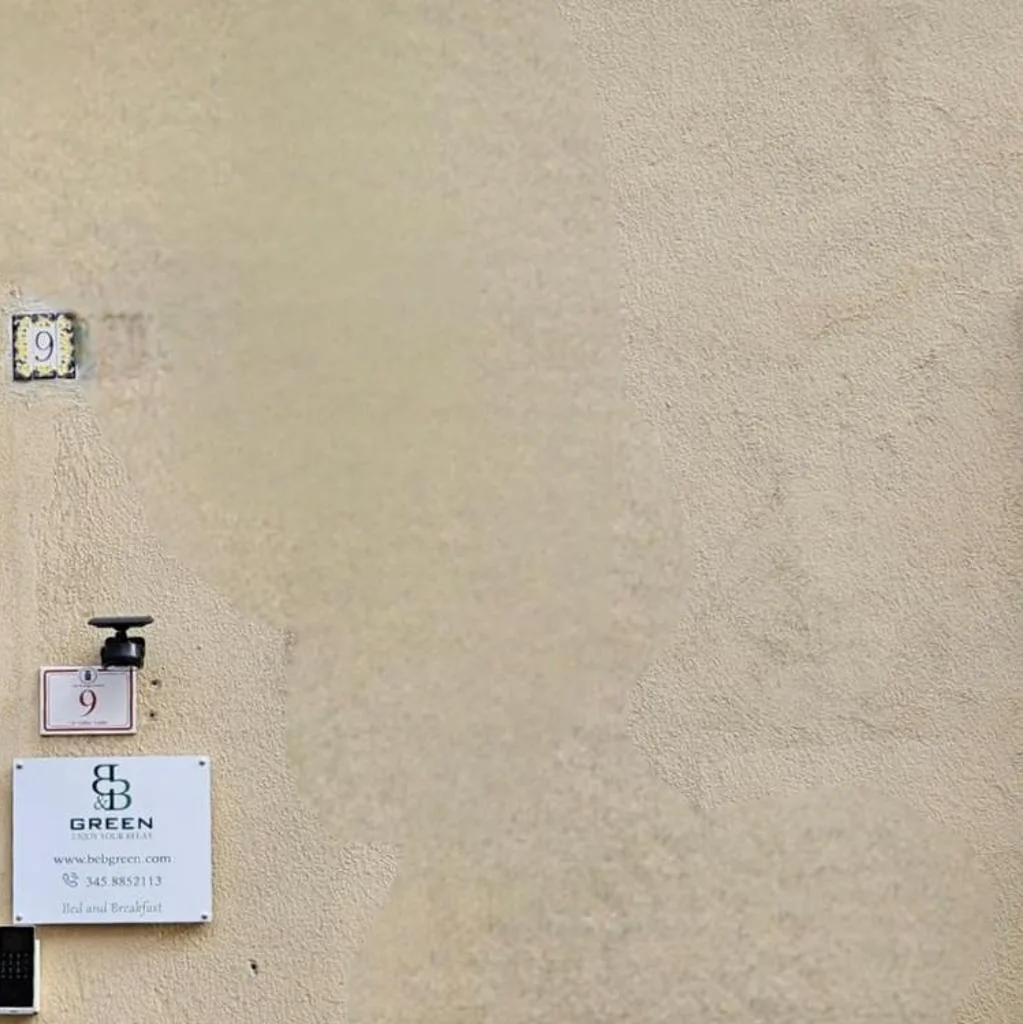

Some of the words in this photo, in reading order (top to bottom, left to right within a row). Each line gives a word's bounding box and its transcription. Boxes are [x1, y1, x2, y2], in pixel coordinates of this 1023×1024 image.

[35, 331, 54, 362] 9
[79, 689, 97, 717] 9
[70, 817, 153, 830] GREEN
[53, 854, 172, 866] www.bebgreen.com
[86, 876, 107, 887] 345
[111, 875, 162, 887] 8852113
[62, 901, 83, 914] Bed
[86, 900, 107, 914] and
[111, 900, 162, 917] Breakfast
